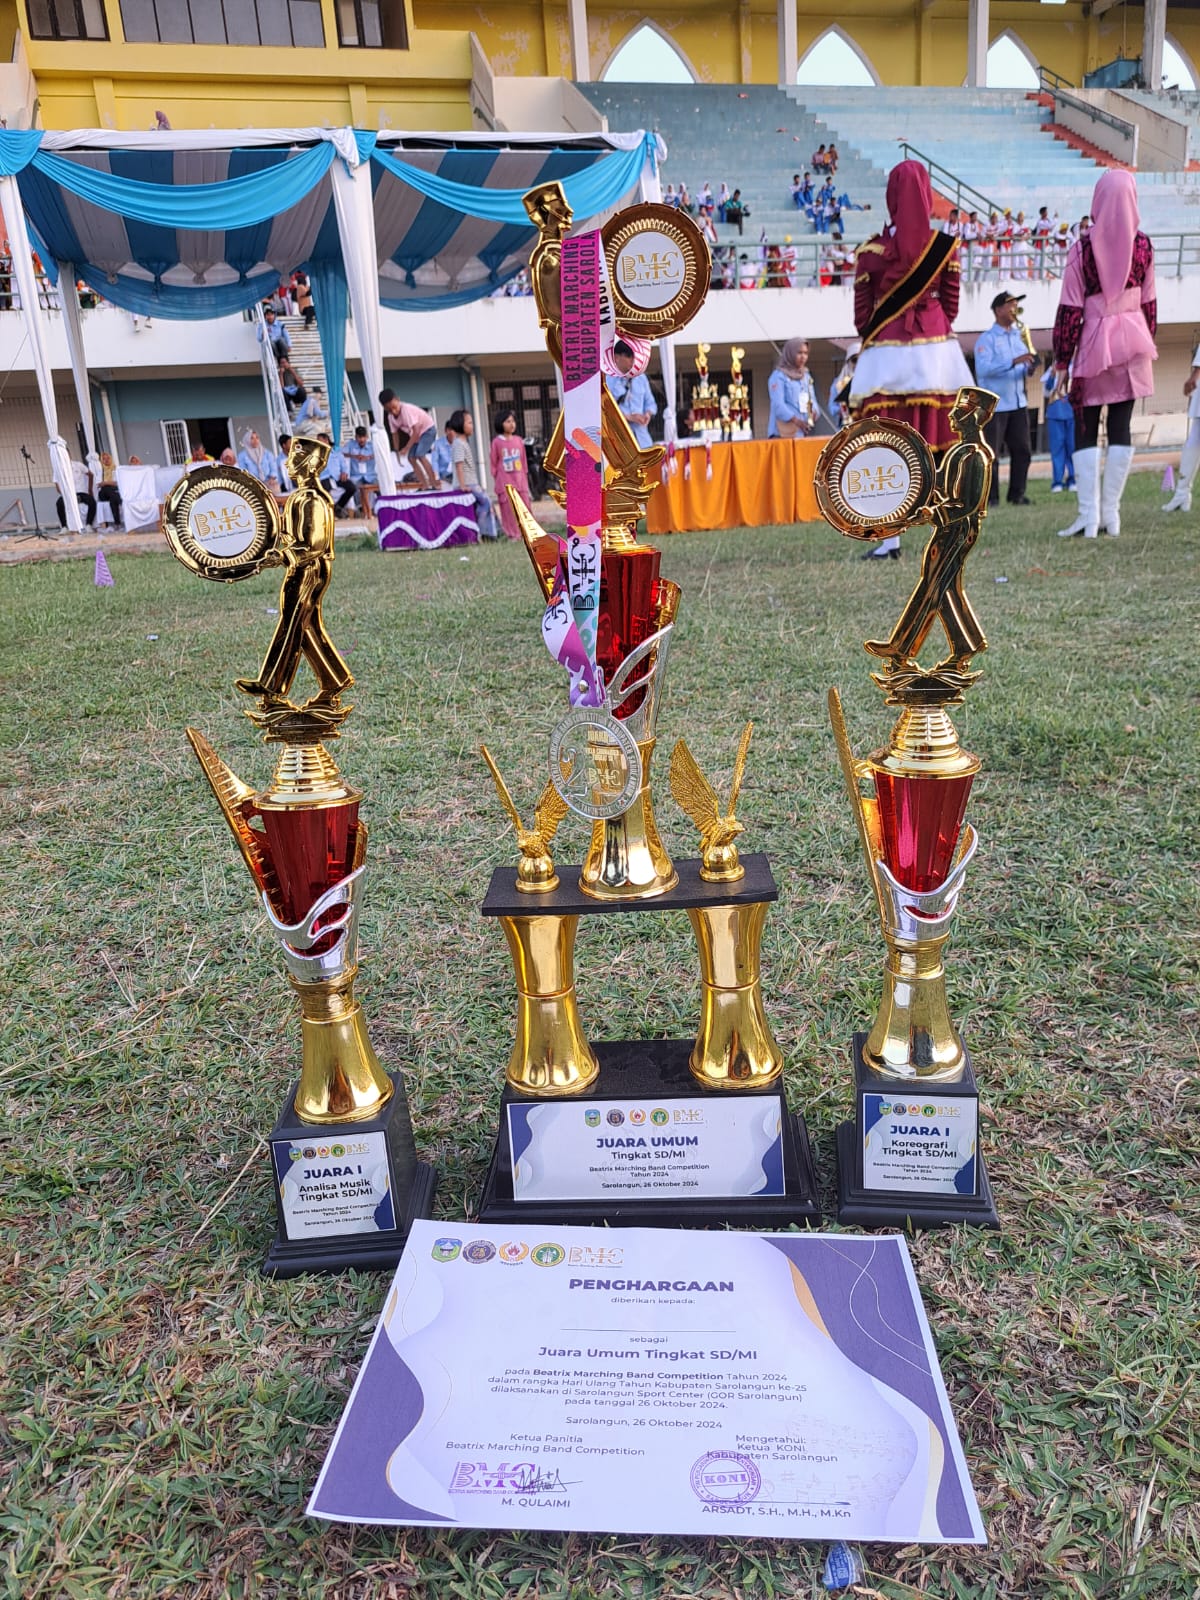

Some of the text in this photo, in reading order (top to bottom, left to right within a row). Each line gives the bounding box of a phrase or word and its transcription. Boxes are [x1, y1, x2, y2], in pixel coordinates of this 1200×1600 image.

[622, 251, 679, 282] BMC
[580, 230, 596, 375] KABUPATEN SAROLA
[563, 243, 581, 381] BEATRIX MARCHING
[847, 464, 904, 494] BMC
[194, 504, 251, 537] BMC
[890, 1125, 950, 1136] JUARA I
[596, 1135, 699, 1148] JUARA UMUM
[891, 1139, 948, 1150] Koreografi
[611, 1150, 686, 1161] Tingkat SD/MI
[882, 1148, 957, 1158] Tingkat SD/MI
[303, 1165, 362, 1179] JUARA I
[299, 1179, 371, 1193] Analisa Musik
[298, 1187, 373, 1202] Tingkat SD/MI
[568, 1246, 624, 1264] BMC
[569, 1278, 735, 1292] PENGHARGAAN
[610, 1296, 696, 1305] diberikan kepada:
[629, 1336, 668, 1344] sebagai
[538, 1346, 758, 1361] Juara Umum Tingkat SD/MI
[504, 1368, 530, 1376] pada
[533, 1368, 571, 1377] Beatrix
[573, 1370, 623, 1379] Marching
[626, 1371, 654, 1379] Band
[657, 1372, 724, 1381] Competition
[762, 1373, 787, 1381] 2024
[487, 1376, 520, 1384] dalam
[523, 1378, 559, 1386] rangka
[585, 1380, 616, 1388] Ulang
[619, 1380, 652, 1388] Tahun
[654, 1381, 712, 1390] Kabupaten
[715, 1382, 776, 1391] Sarolangun
[778, 1384, 807, 1392] ke-25
[490, 1385, 802, 1402] dilaksanakan di Sarolangun Sport Center (GOR Sarolangun)
[564, 1398, 728, 1409] pada tanggal 26 Oktober 2024.
[565, 1416, 722, 1429] Sarolangun, 26 Oktober 2024
[510, 1433, 583, 1443] Ketua Panitia
[445, 1441, 645, 1456] Beatrix Marching Band Competition
[707, 1450, 838, 1463] Kabupaten Sarolangun
[703, 1472, 748, 1485] KONI
[501, 1497, 571, 1508] M. QULAIMI
[820, 1509, 851, 1518] M.Kn
